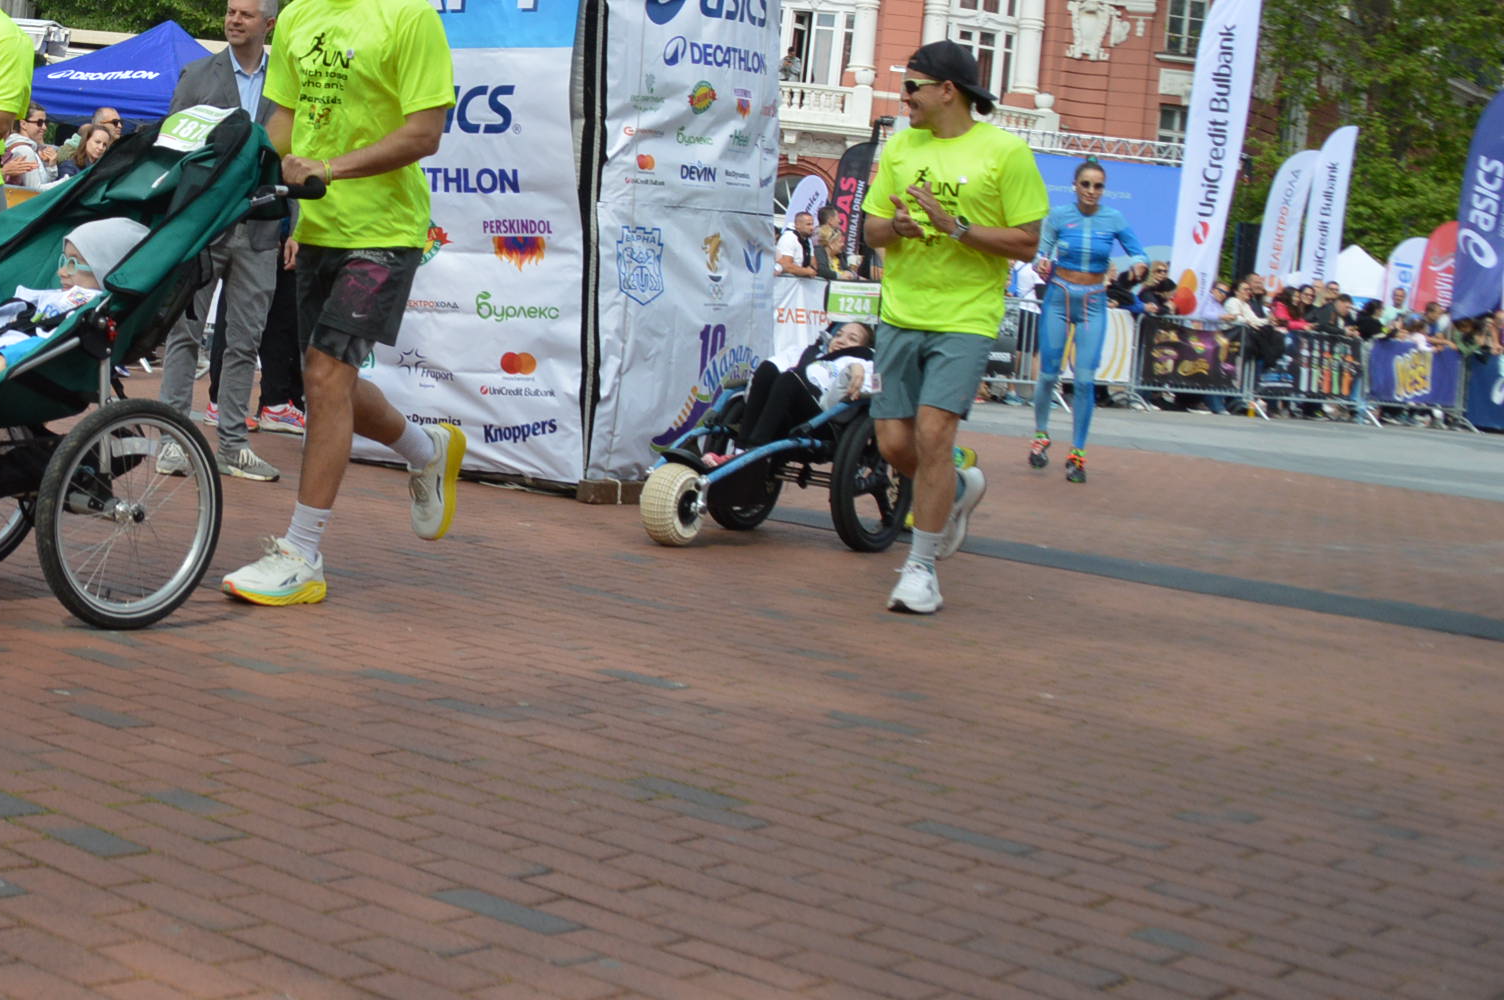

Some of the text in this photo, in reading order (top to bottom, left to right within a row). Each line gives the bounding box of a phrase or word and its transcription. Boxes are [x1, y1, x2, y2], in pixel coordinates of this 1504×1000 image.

[690, 42, 767, 76] DECATHLON
[70, 69, 160, 81] DECATHLON
[1198, 24, 1237, 218] UniCredit Bulbank
[421, 167, 520, 193] THLON
[680, 164, 717, 182] DEVIN
[1469, 155, 1504, 232] asics
[482, 218, 553, 235] PERSKINDOL
[846, 180, 866, 255] NATURAL DRINK
[838, 296, 872, 314] 1244
[699, 323, 726, 383] 10
[421, 367, 454, 382] Fraport
[489, 386, 556, 398] UniCredit Bulbank
[483, 417, 558, 444] Knoppers
